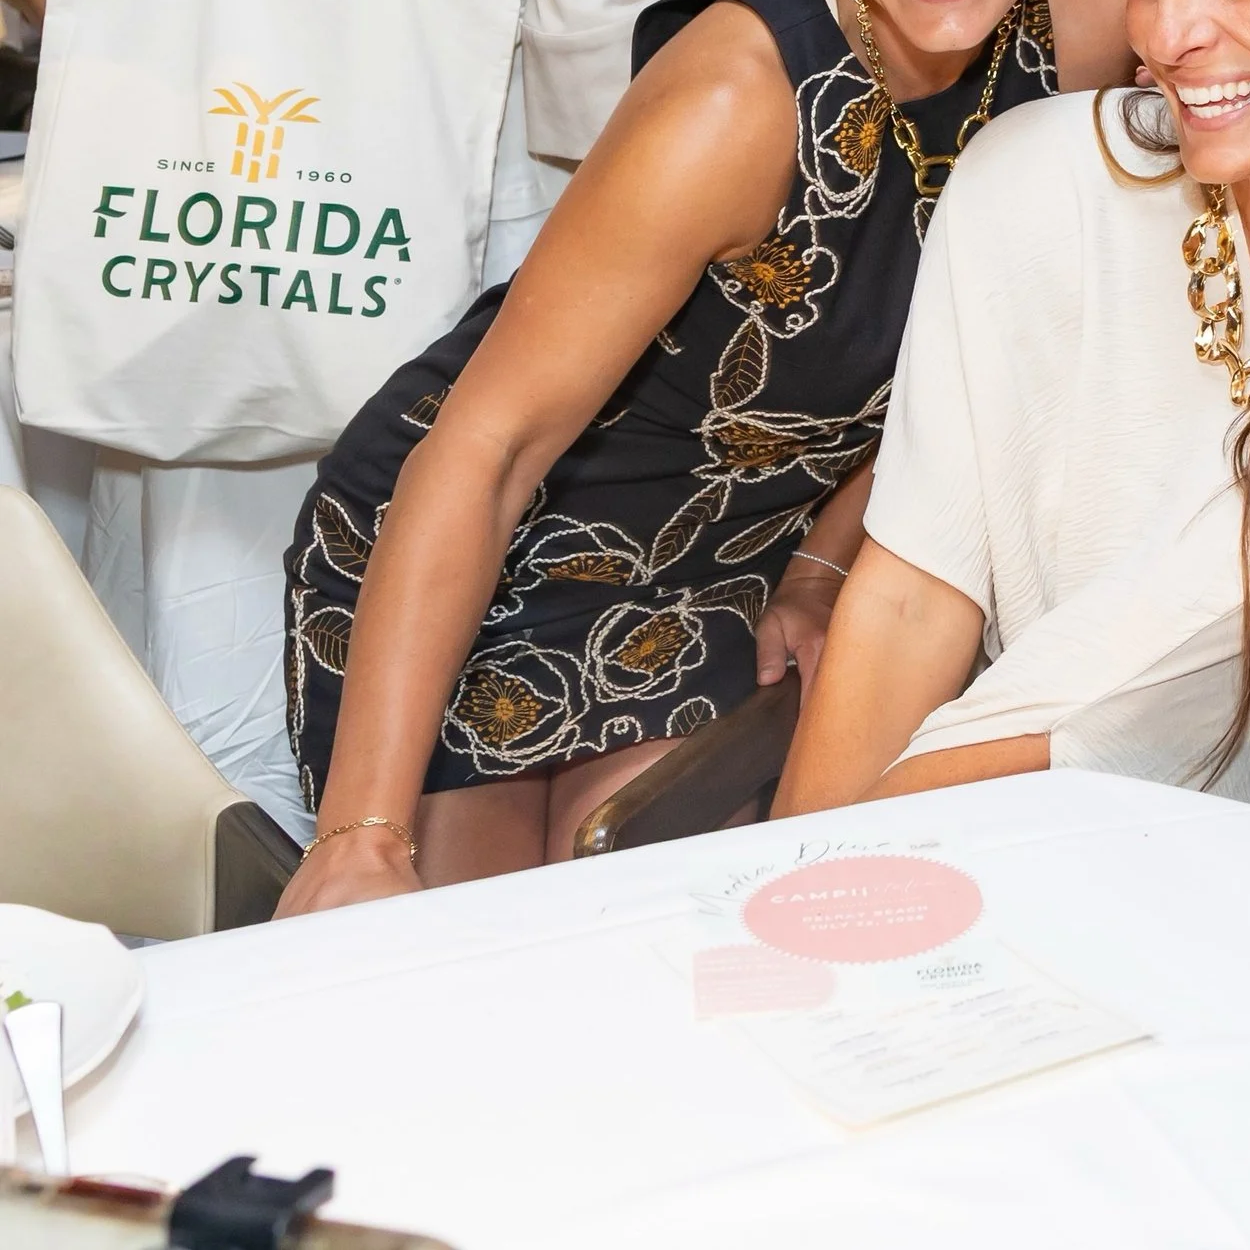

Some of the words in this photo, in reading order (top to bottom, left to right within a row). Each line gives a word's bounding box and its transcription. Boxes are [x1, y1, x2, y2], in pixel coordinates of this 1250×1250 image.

[156, 158, 216, 173] SINCE
[296, 169, 353, 184] 1960
[92, 184, 413, 263] FLORIDA
